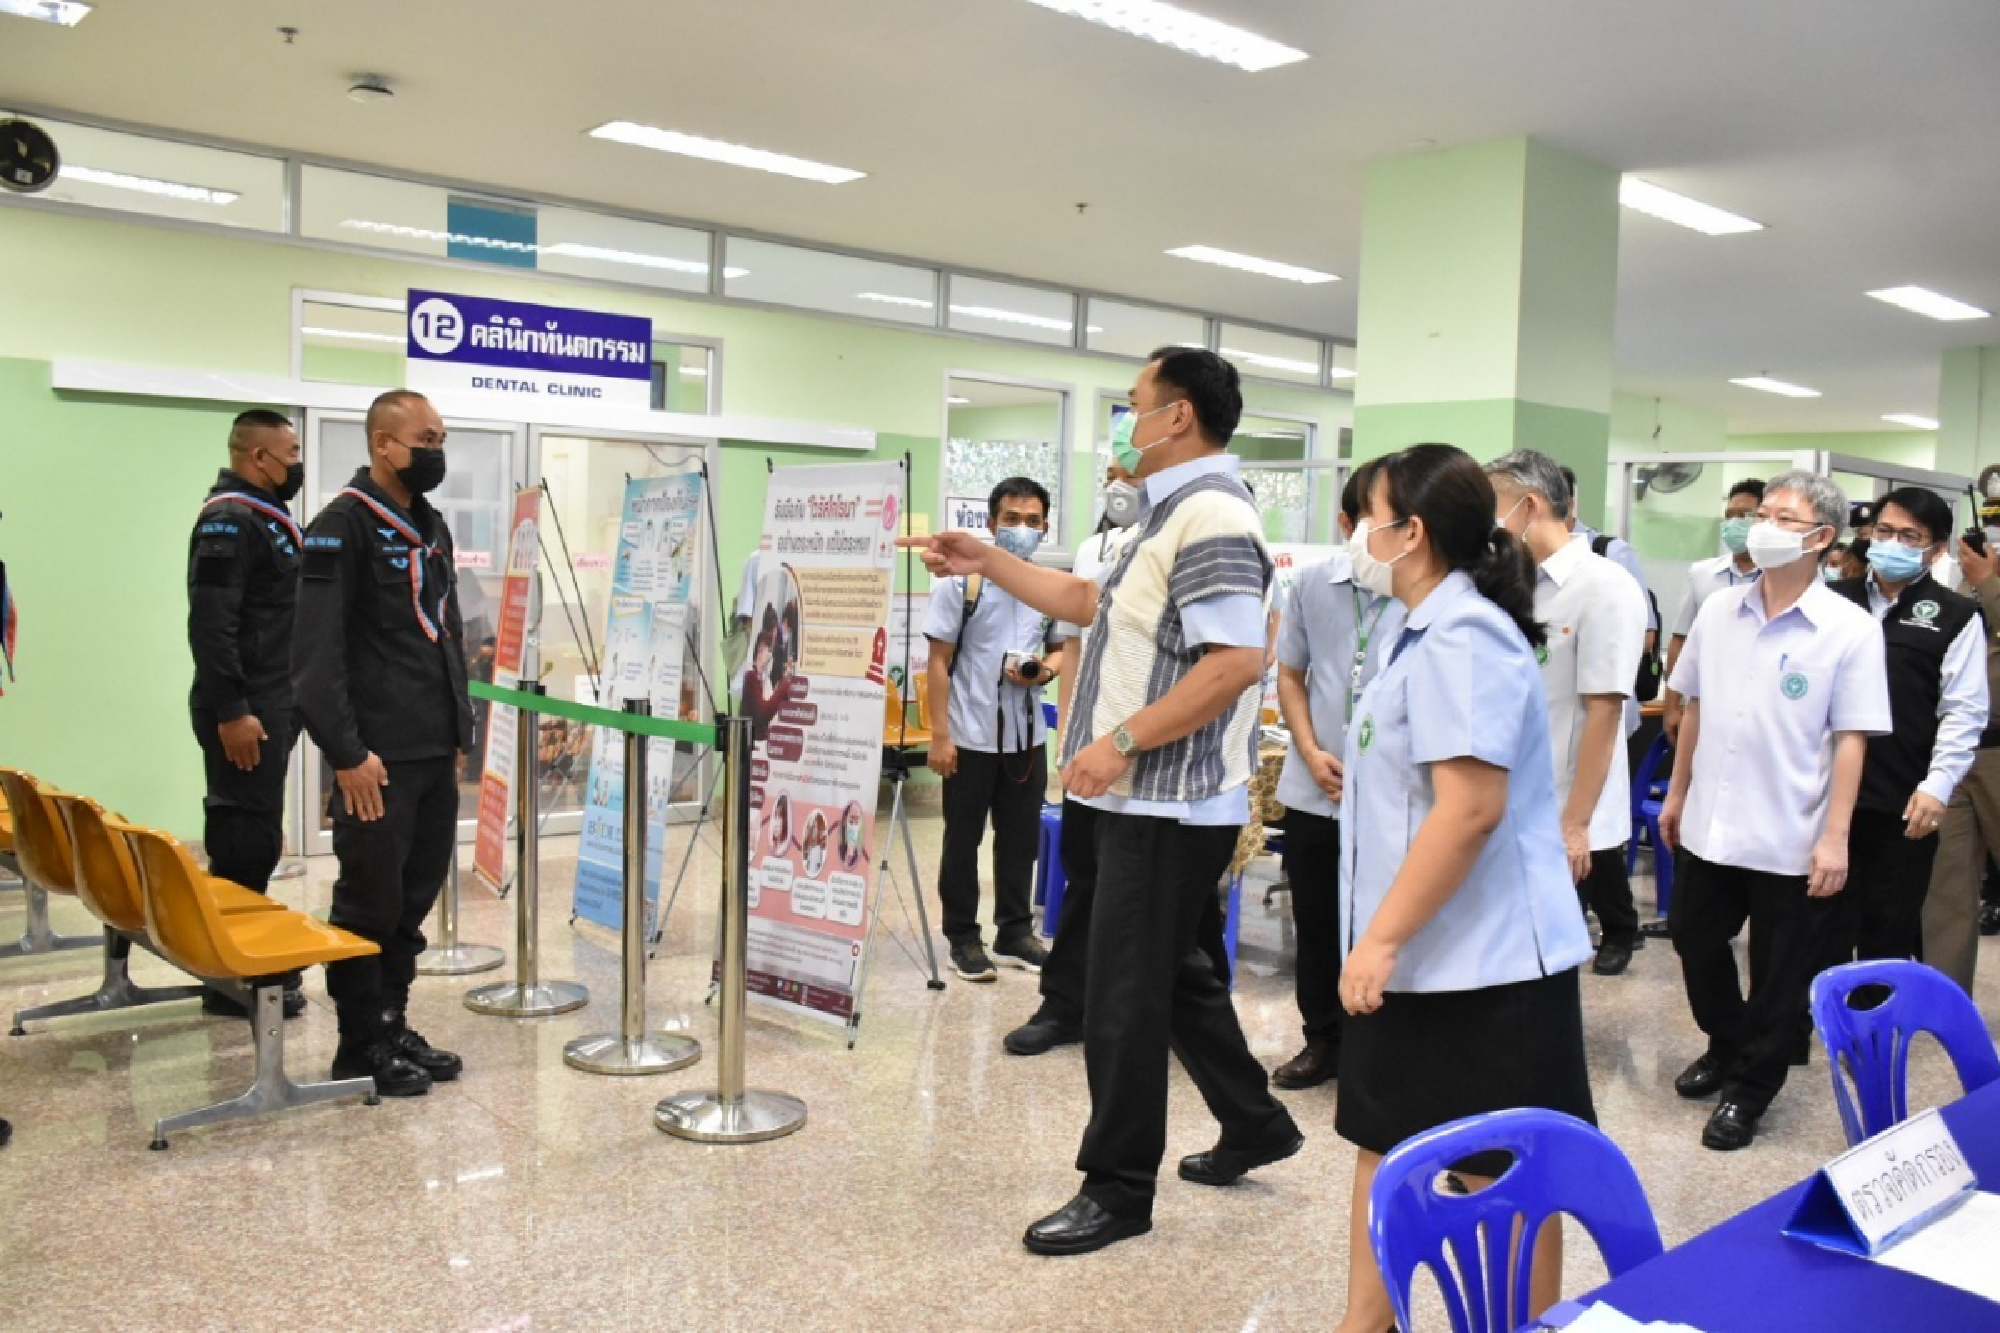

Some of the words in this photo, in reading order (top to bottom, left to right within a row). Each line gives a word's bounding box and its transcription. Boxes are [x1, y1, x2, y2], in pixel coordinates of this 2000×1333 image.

[417, 312, 456, 341] 12
[470, 315, 646, 364] คลินิกทันตกรรม
[471, 376, 539, 394] DENTAL
[547, 382, 603, 399] CLINIC
[1851, 1139, 1962, 1221] ตรวจคัดกรอง
